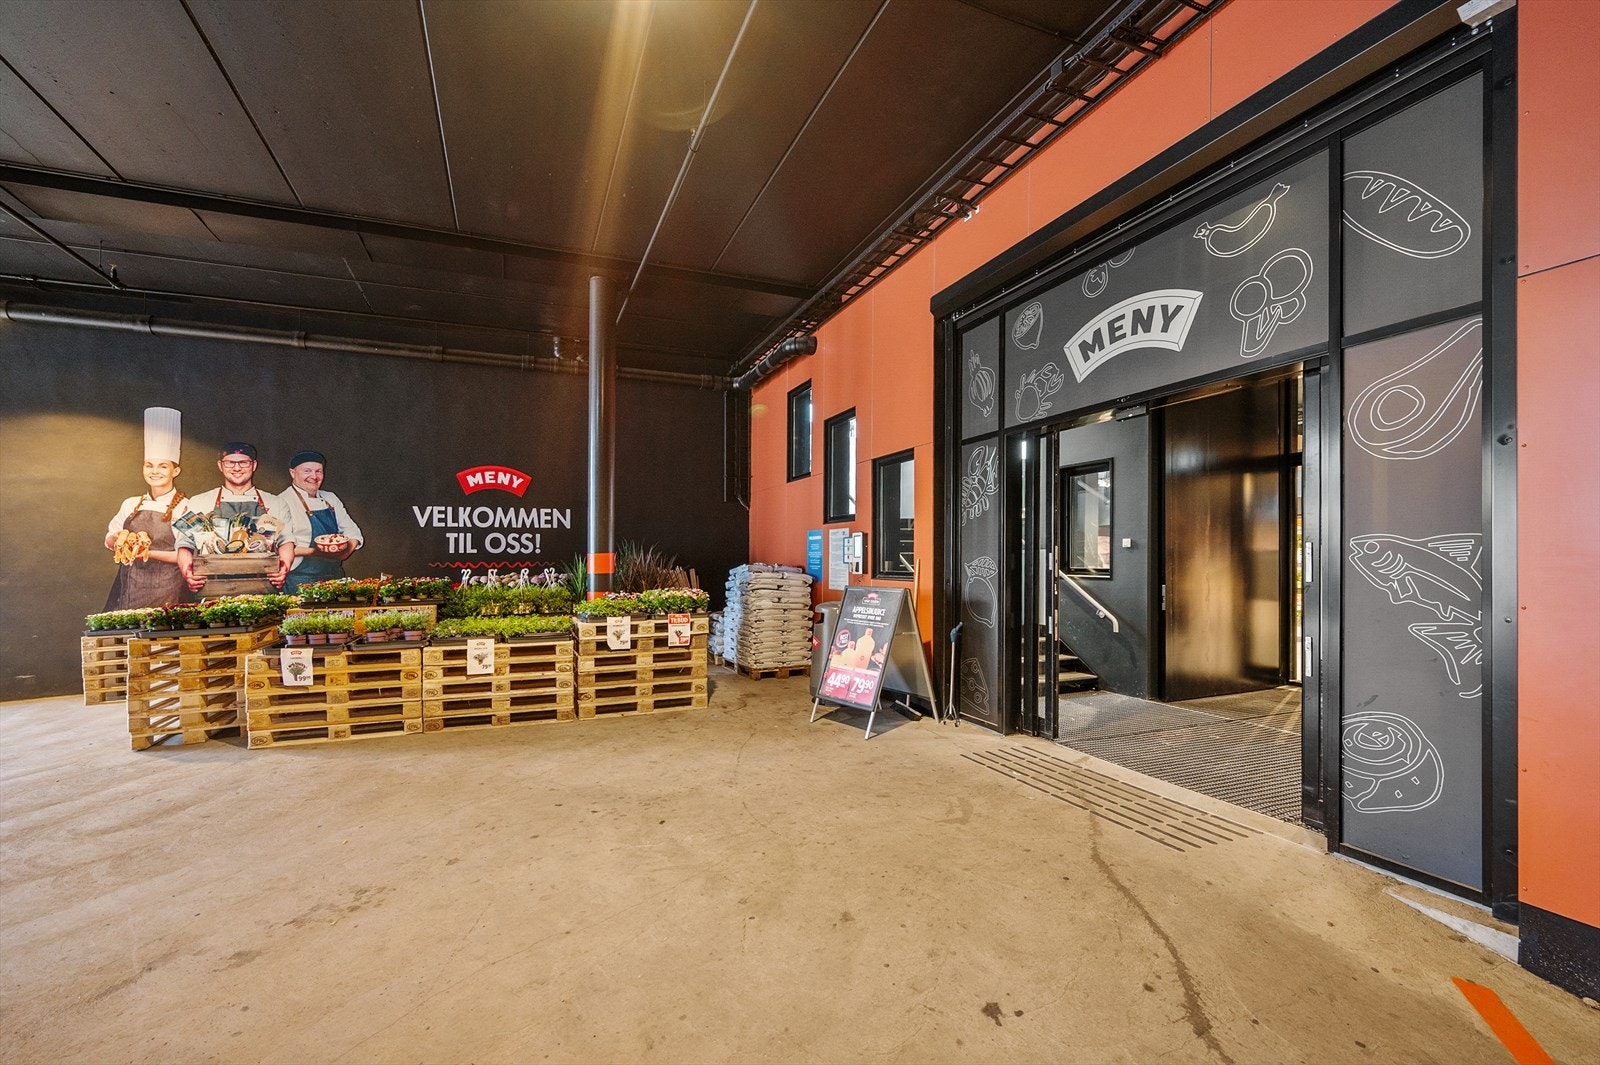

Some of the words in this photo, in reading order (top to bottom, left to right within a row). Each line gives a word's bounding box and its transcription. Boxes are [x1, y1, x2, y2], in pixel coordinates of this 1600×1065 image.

[1078, 304, 1184, 364] MENY
[465, 471, 524, 488] MENY
[412, 505, 571, 529] VELKOMMEN
[446, 532, 478, 554] TIL
[484, 532, 542, 554] OSS!
